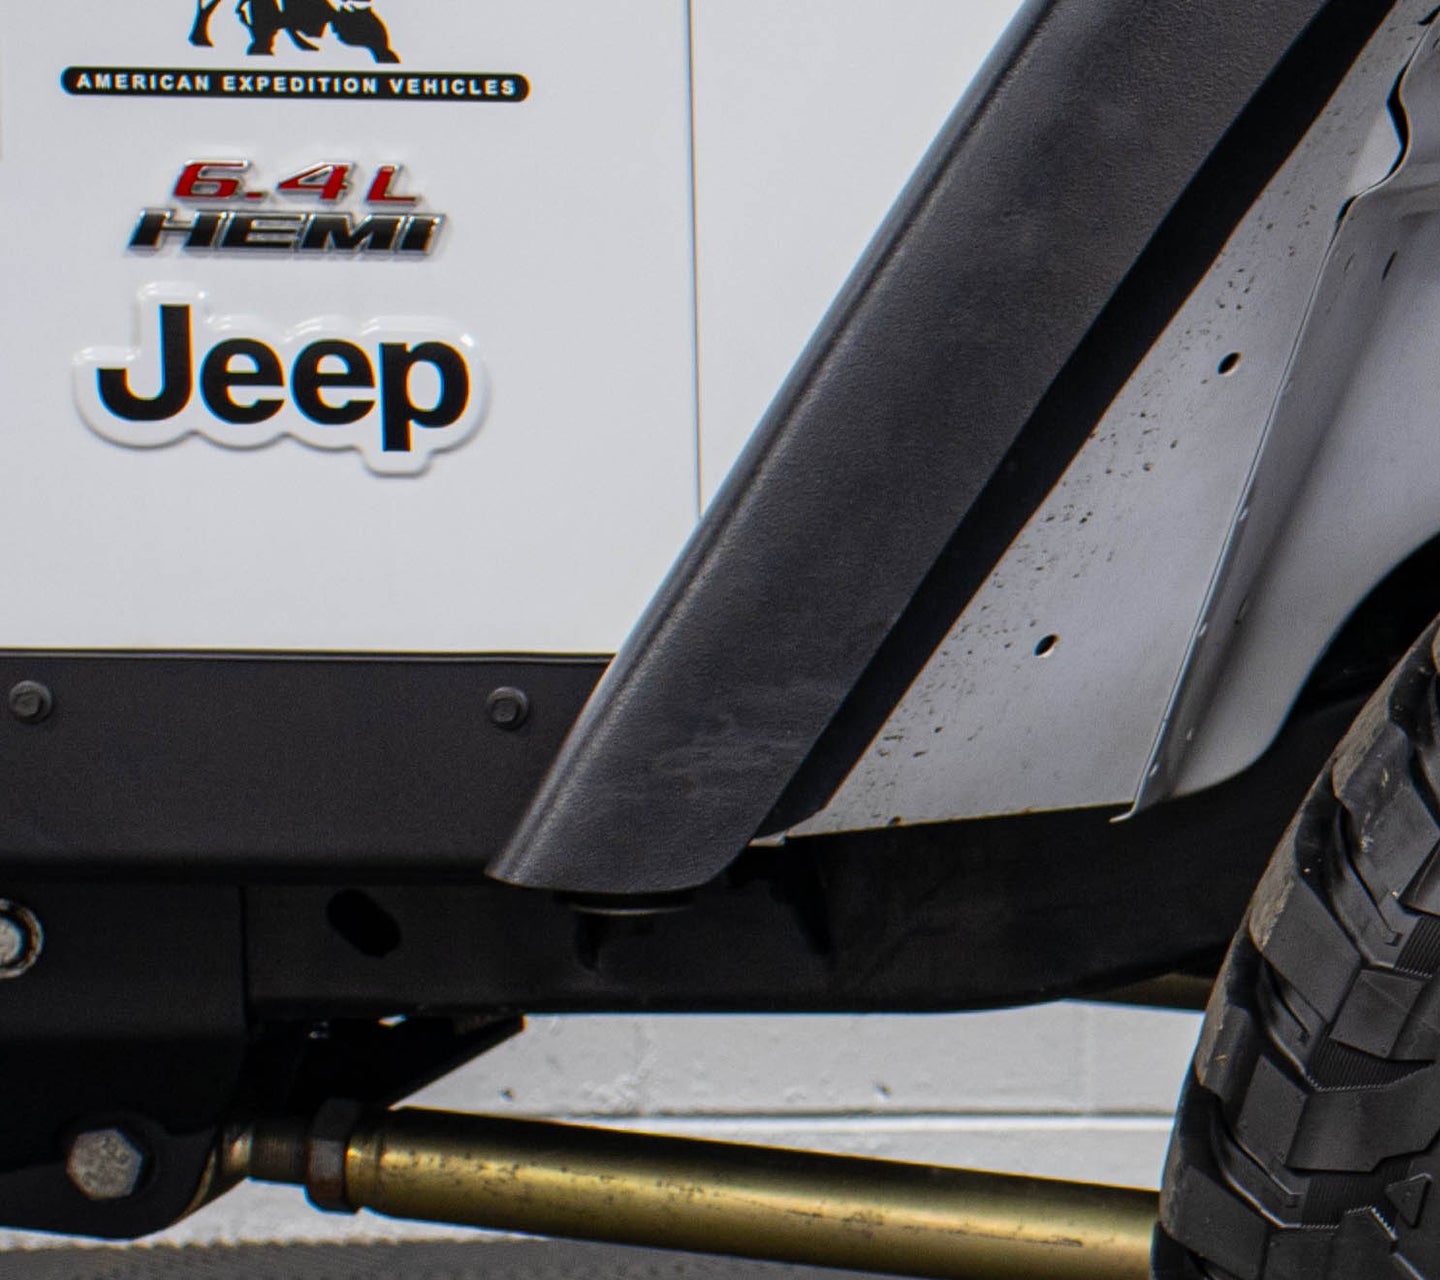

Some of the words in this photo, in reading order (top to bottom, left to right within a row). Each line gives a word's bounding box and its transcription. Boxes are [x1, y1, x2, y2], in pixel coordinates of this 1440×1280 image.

[75, 72, 210, 91] AMERICAN
[223, 74, 377, 94] EXPEDITION
[389, 77, 517, 96] VEHICLES
[171, 159, 423, 206] 6.4L
[124, 208, 447, 260] HEMI
[96, 303, 470, 452] Jeep
